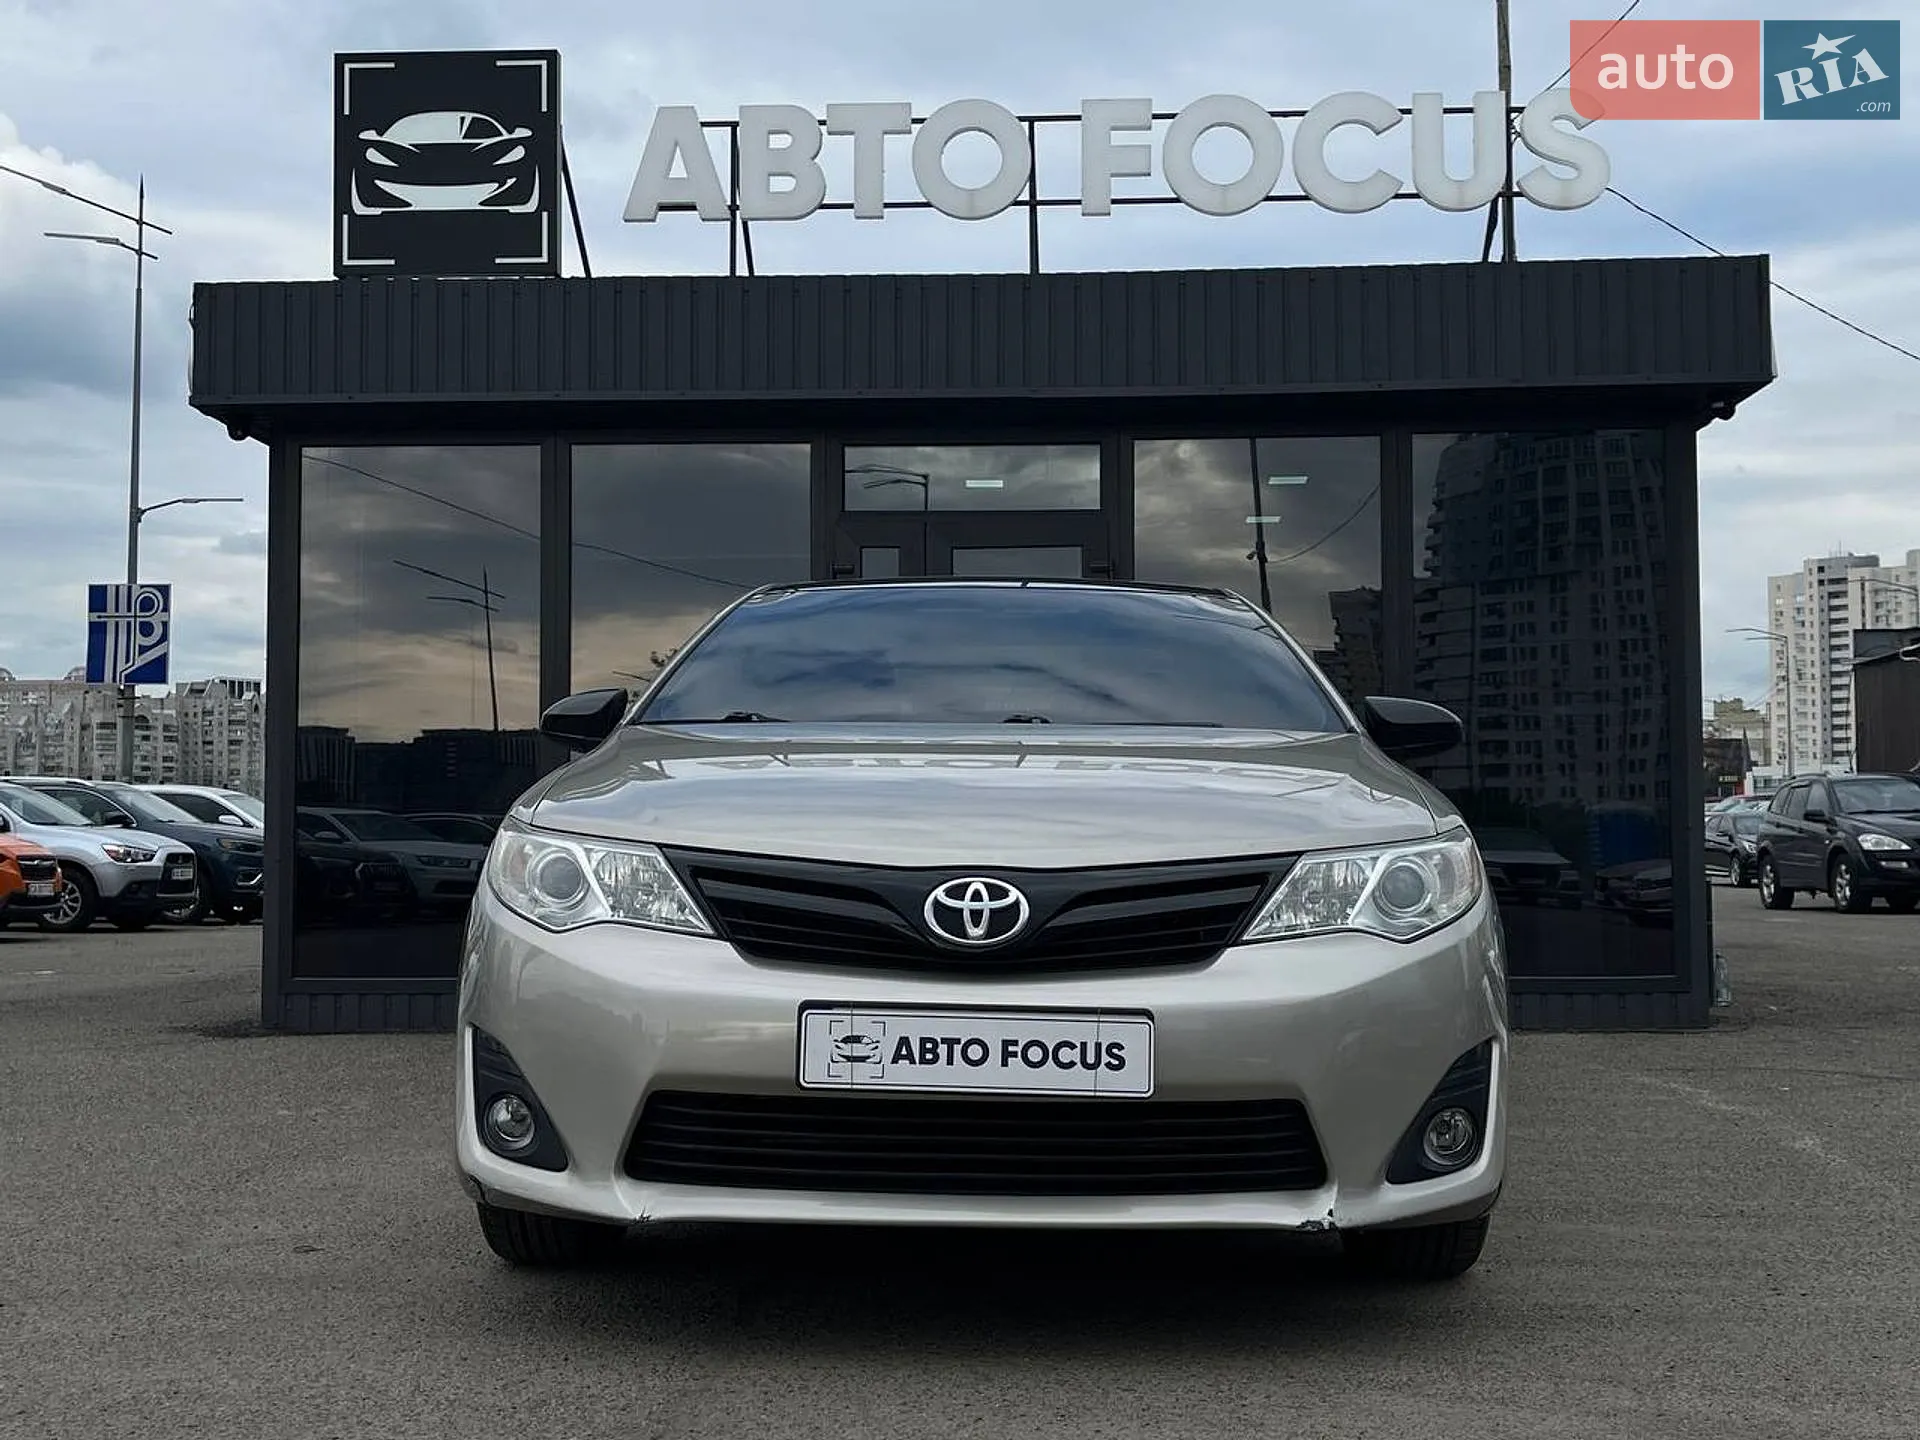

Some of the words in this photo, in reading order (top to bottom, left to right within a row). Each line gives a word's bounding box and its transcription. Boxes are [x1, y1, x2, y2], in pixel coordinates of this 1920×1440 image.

[623, 98, 1032, 222] АВТО
[1080, 88, 1611, 217] FOCUS
[890, 1036, 990, 1068] АВТО
[1000, 1039, 1127, 1071] FOCUS
